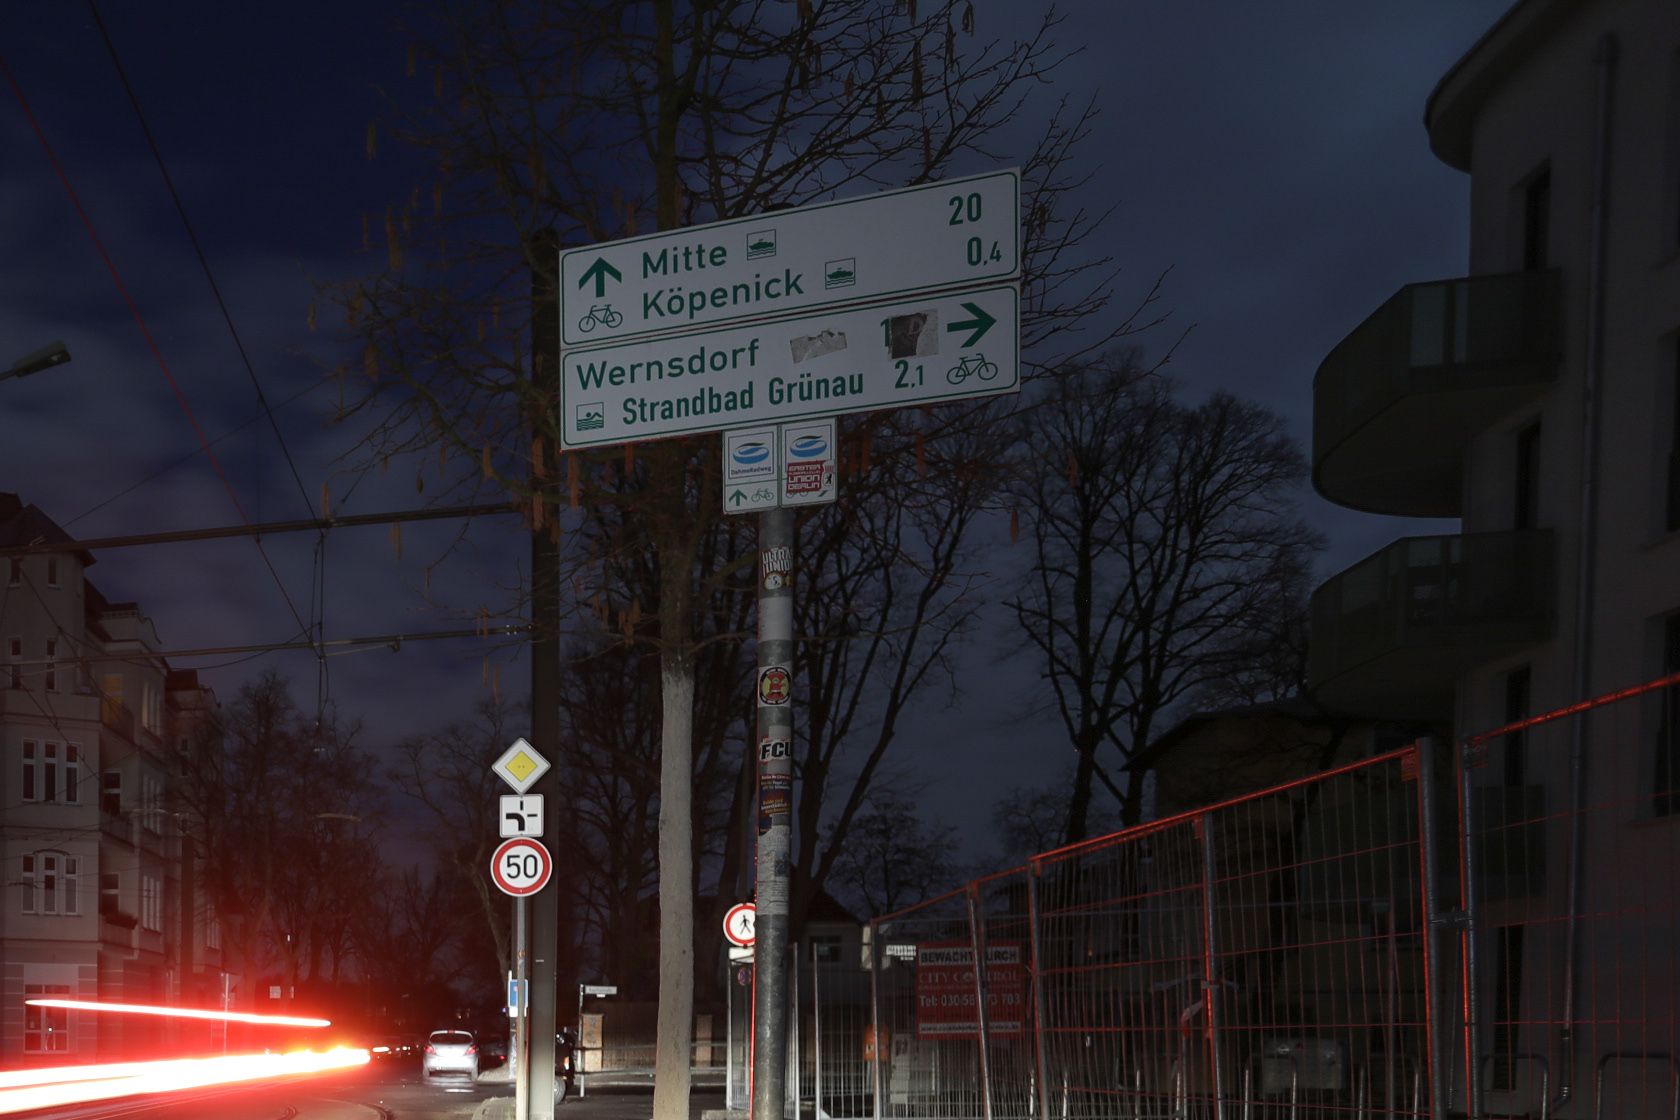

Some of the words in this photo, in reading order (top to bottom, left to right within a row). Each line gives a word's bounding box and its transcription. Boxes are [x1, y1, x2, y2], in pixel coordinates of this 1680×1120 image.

[642, 243, 728, 280] Mitte
[949, 192, 982, 226] 20
[642, 268, 805, 321] Köpenick
[966, 236, 1002, 266] 0,4
[576, 338, 760, 391] Wernsdorf
[622, 381, 755, 425] Strandbad
[768, 370, 865, 406] Grünau
[894, 359, 924, 389] 2,1
[506, 854, 538, 879] 50
